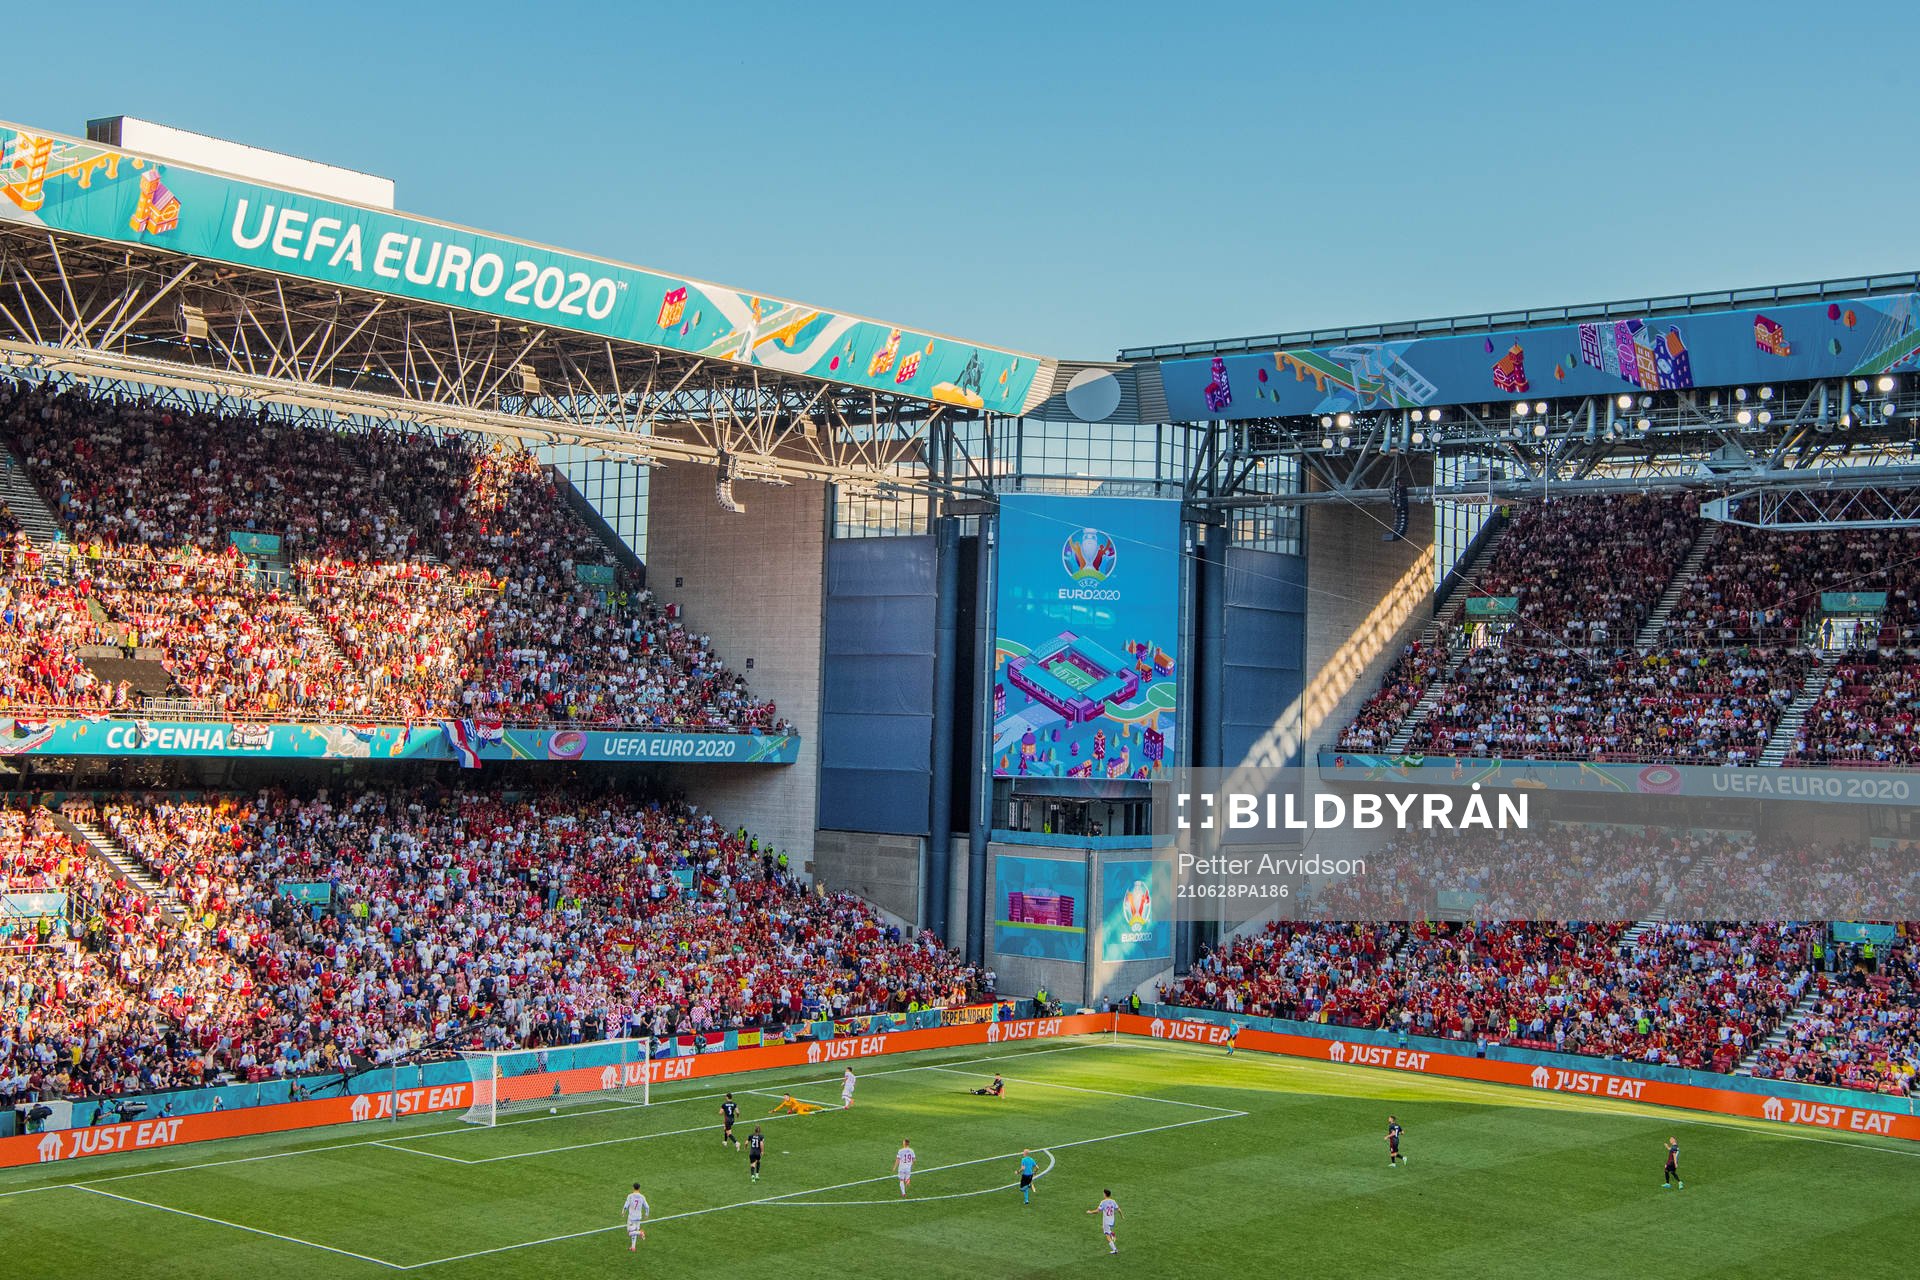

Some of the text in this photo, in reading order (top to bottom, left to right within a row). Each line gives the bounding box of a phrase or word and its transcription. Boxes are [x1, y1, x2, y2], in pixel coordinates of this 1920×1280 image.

[232, 199, 362, 272] UEFA
[373, 232, 504, 297] EURO
[604, 738, 736, 757] UEFA EURO 2020
[1712, 773, 1910, 800] UEFA EURO 2020
[1003, 1019, 1063, 1041] JUST EAT
[1168, 1022, 1229, 1043] JUST EA
[824, 1036, 887, 1062] JUST EAT
[1349, 1045, 1430, 1070] JUST EAT
[624, 1058, 695, 1086] JUST EAT
[1554, 1071, 1646, 1099] JUST EAT
[375, 1085, 466, 1119] JUST EAT
[1789, 1102, 1896, 1134] JUST EAT
[68, 1119, 184, 1158] JUST EAT
[751, 1138, 759, 1148] 21
[903, 1153, 912, 1164] 19
[634, 1199, 639, 1210] 7
